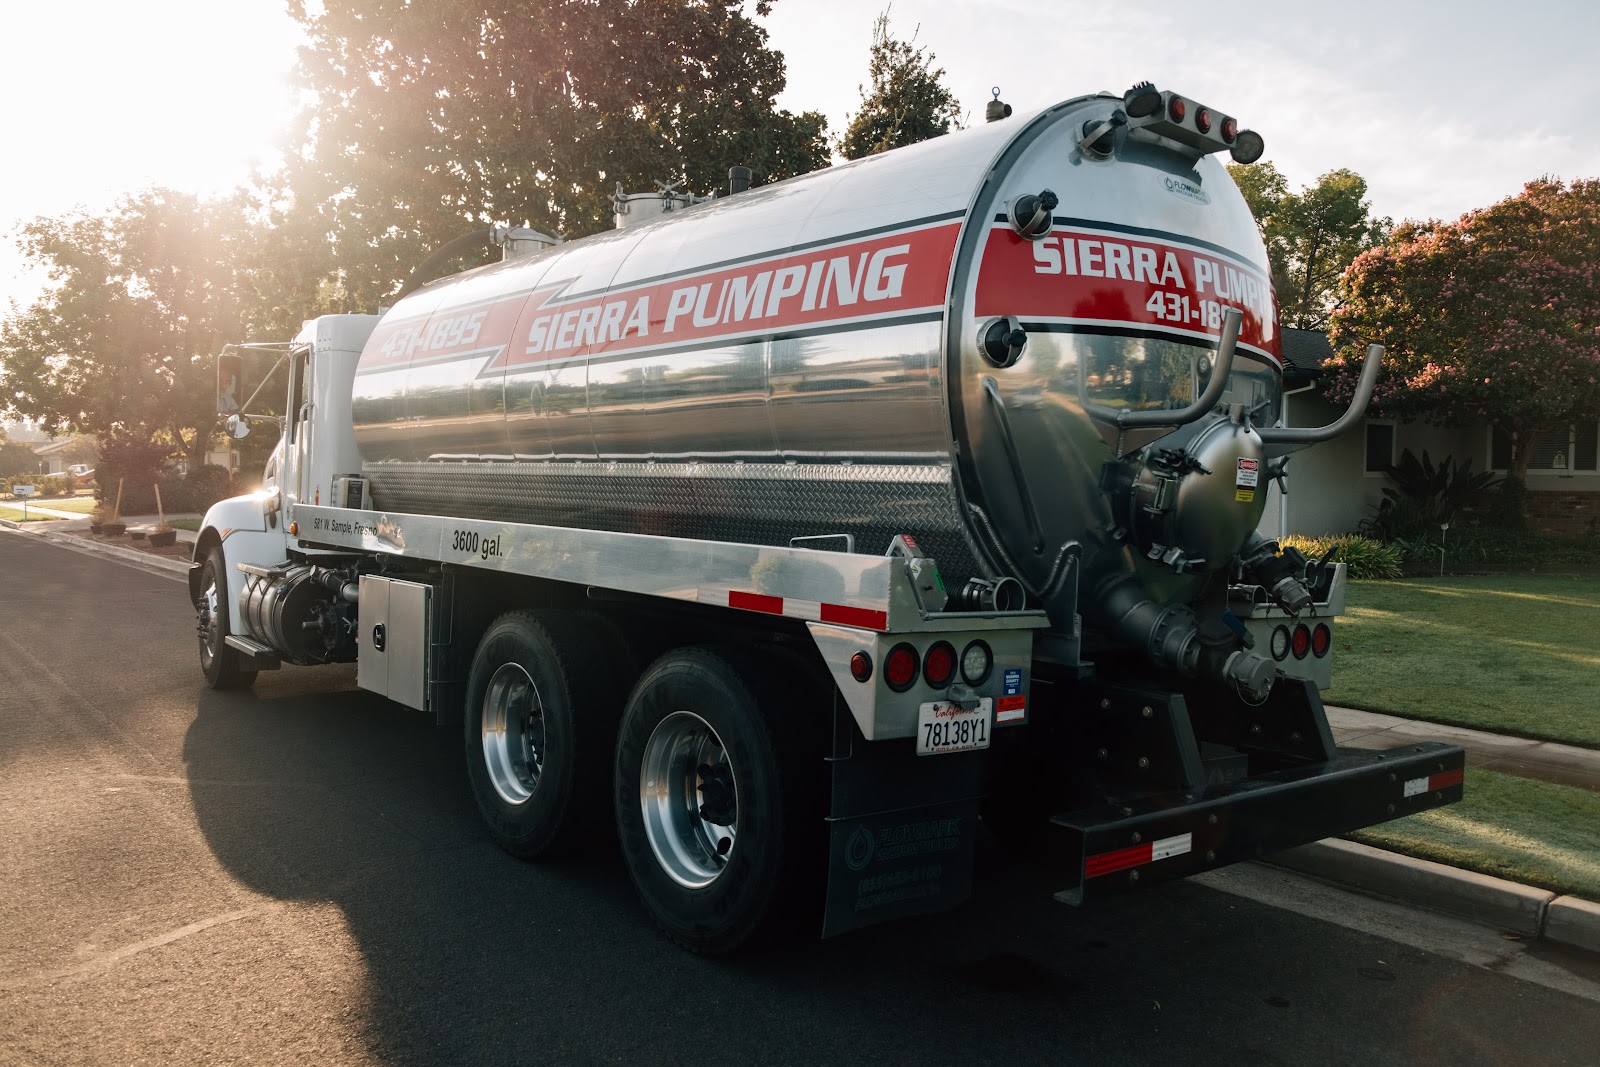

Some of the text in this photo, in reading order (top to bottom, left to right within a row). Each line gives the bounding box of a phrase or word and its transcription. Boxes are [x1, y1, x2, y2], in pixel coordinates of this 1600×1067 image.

[1032, 237, 1185, 289] SIERRA
[525, 243, 911, 355] SIERRA PUMPING
[1146, 290, 1242, 335] 431-18
[381, 311, 487, 358] 431-1895
[313, 517, 377, 536] 581 W. Sample, Fresno
[452, 529, 503, 560] 3600 gal.
[924, 718, 986, 747] 78138Y1
[936, 744, 973, 752] dmv.ca.gov
